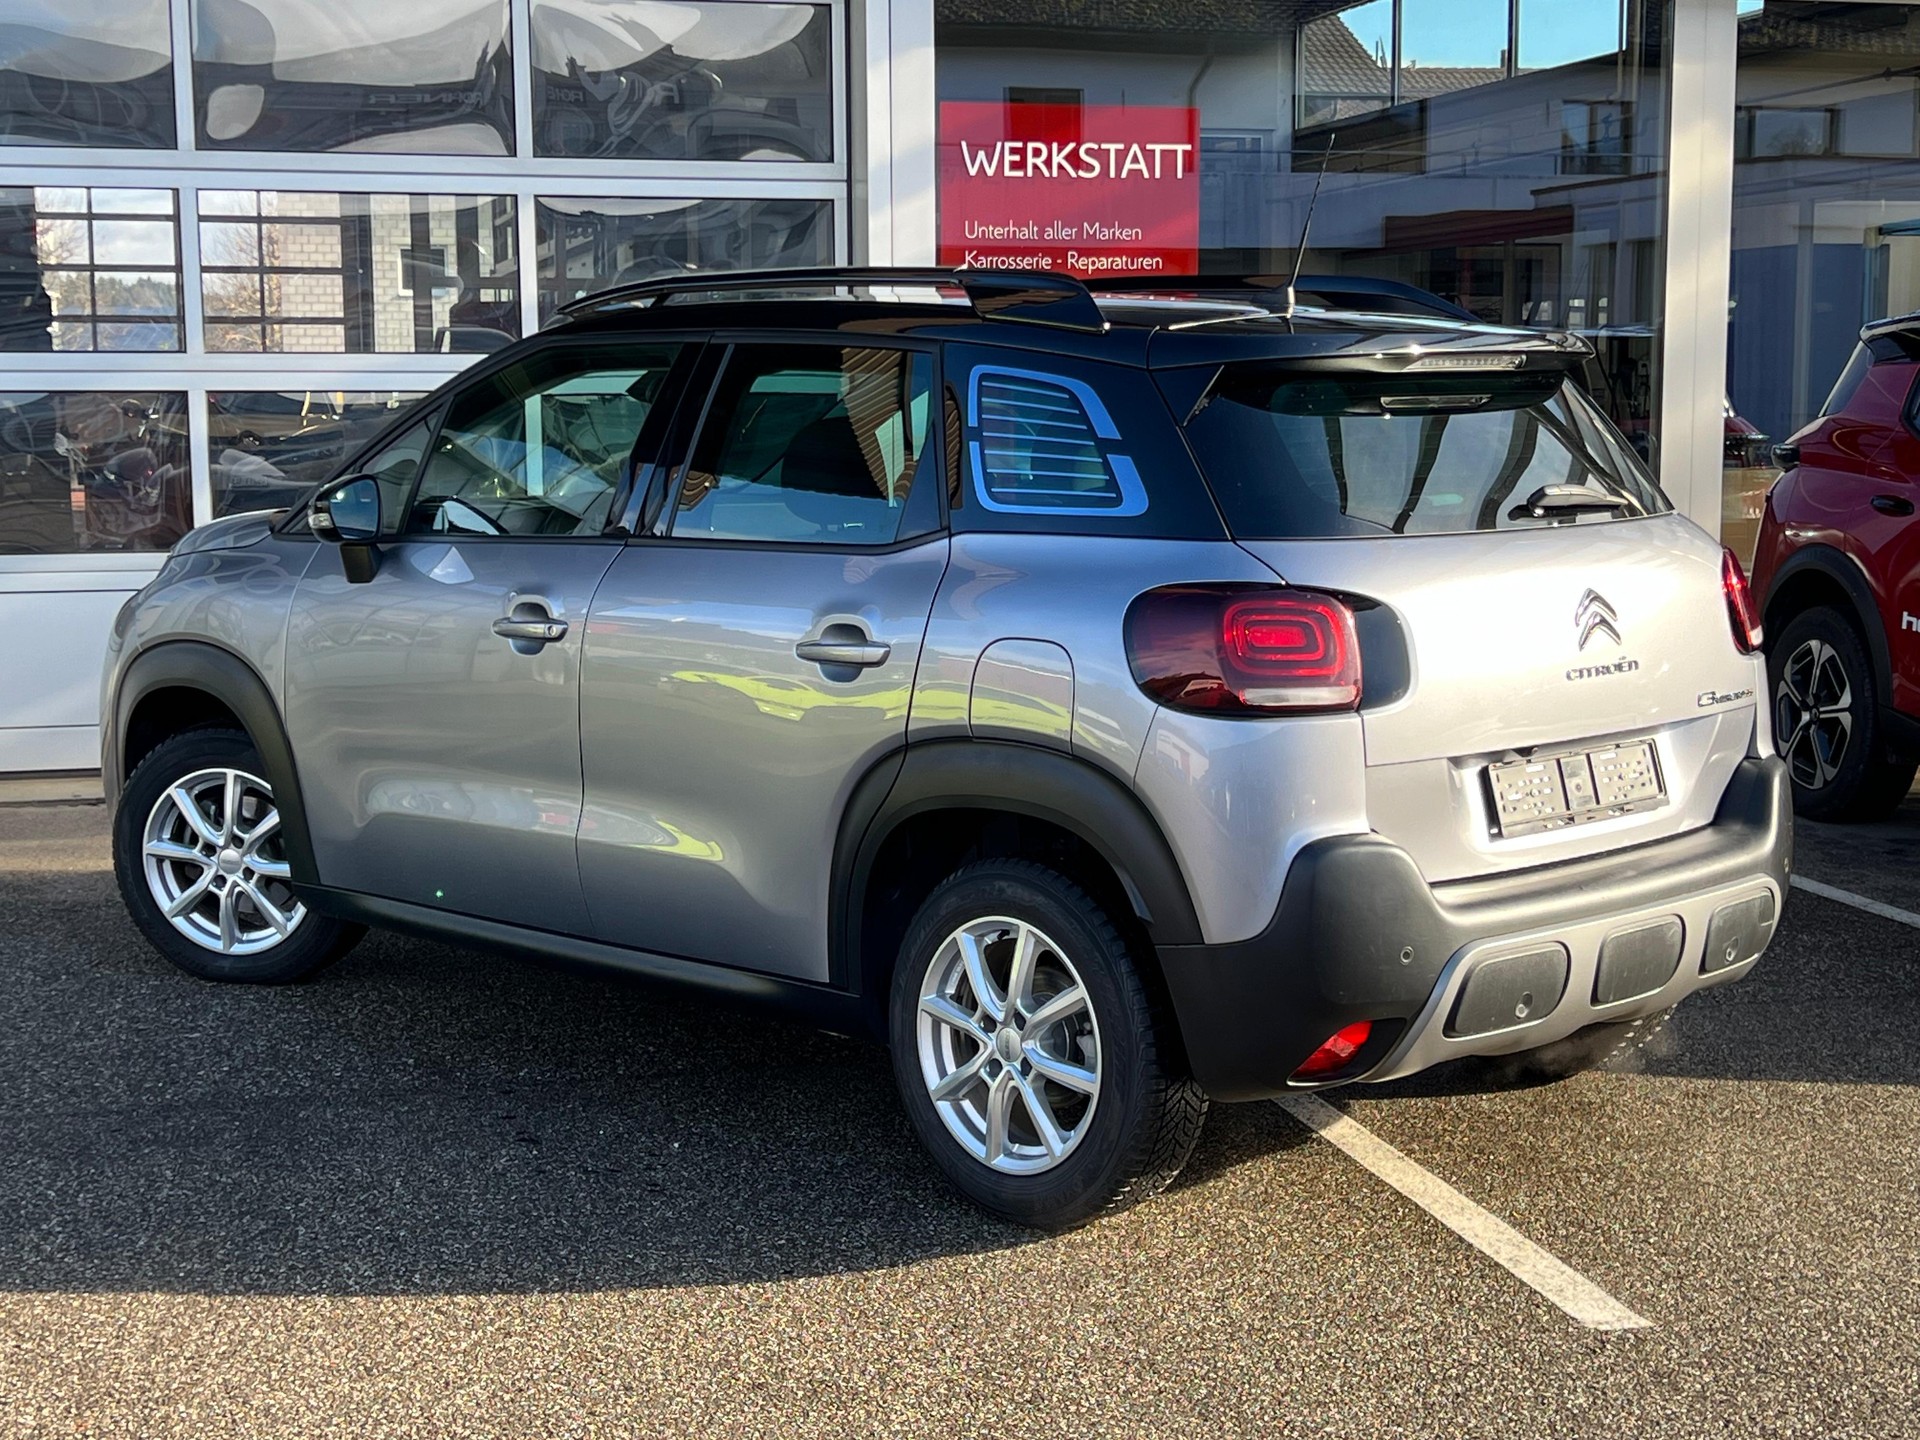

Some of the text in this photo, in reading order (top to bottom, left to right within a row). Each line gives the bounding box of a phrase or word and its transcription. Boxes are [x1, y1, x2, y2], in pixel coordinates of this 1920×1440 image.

[960, 140, 1192, 180] WERKSTATT
[964, 219, 1142, 241] Unterhalt aller Marken
[964, 250, 1052, 270] Karrosserie
[1067, 251, 1163, 274] Reparaturen
